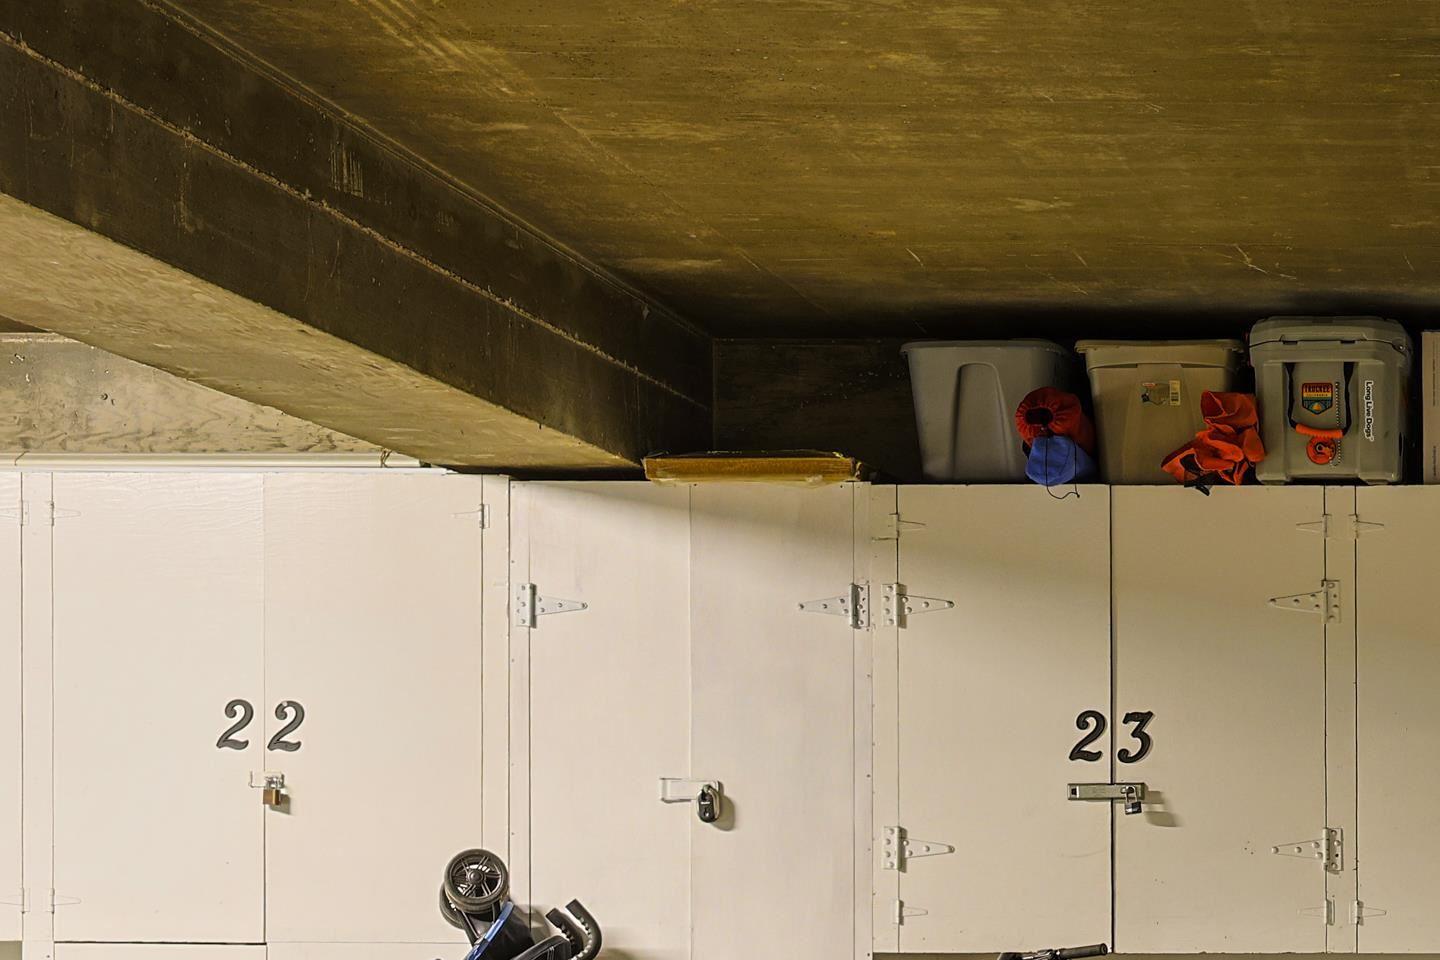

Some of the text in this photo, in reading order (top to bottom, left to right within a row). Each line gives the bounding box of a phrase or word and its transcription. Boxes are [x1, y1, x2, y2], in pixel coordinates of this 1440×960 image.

[1364, 381, 1373, 400] Long
[1364, 418, 1373, 437] Dogs
[216, 698, 305, 752] 22
[1069, 710, 1154, 763] 23
